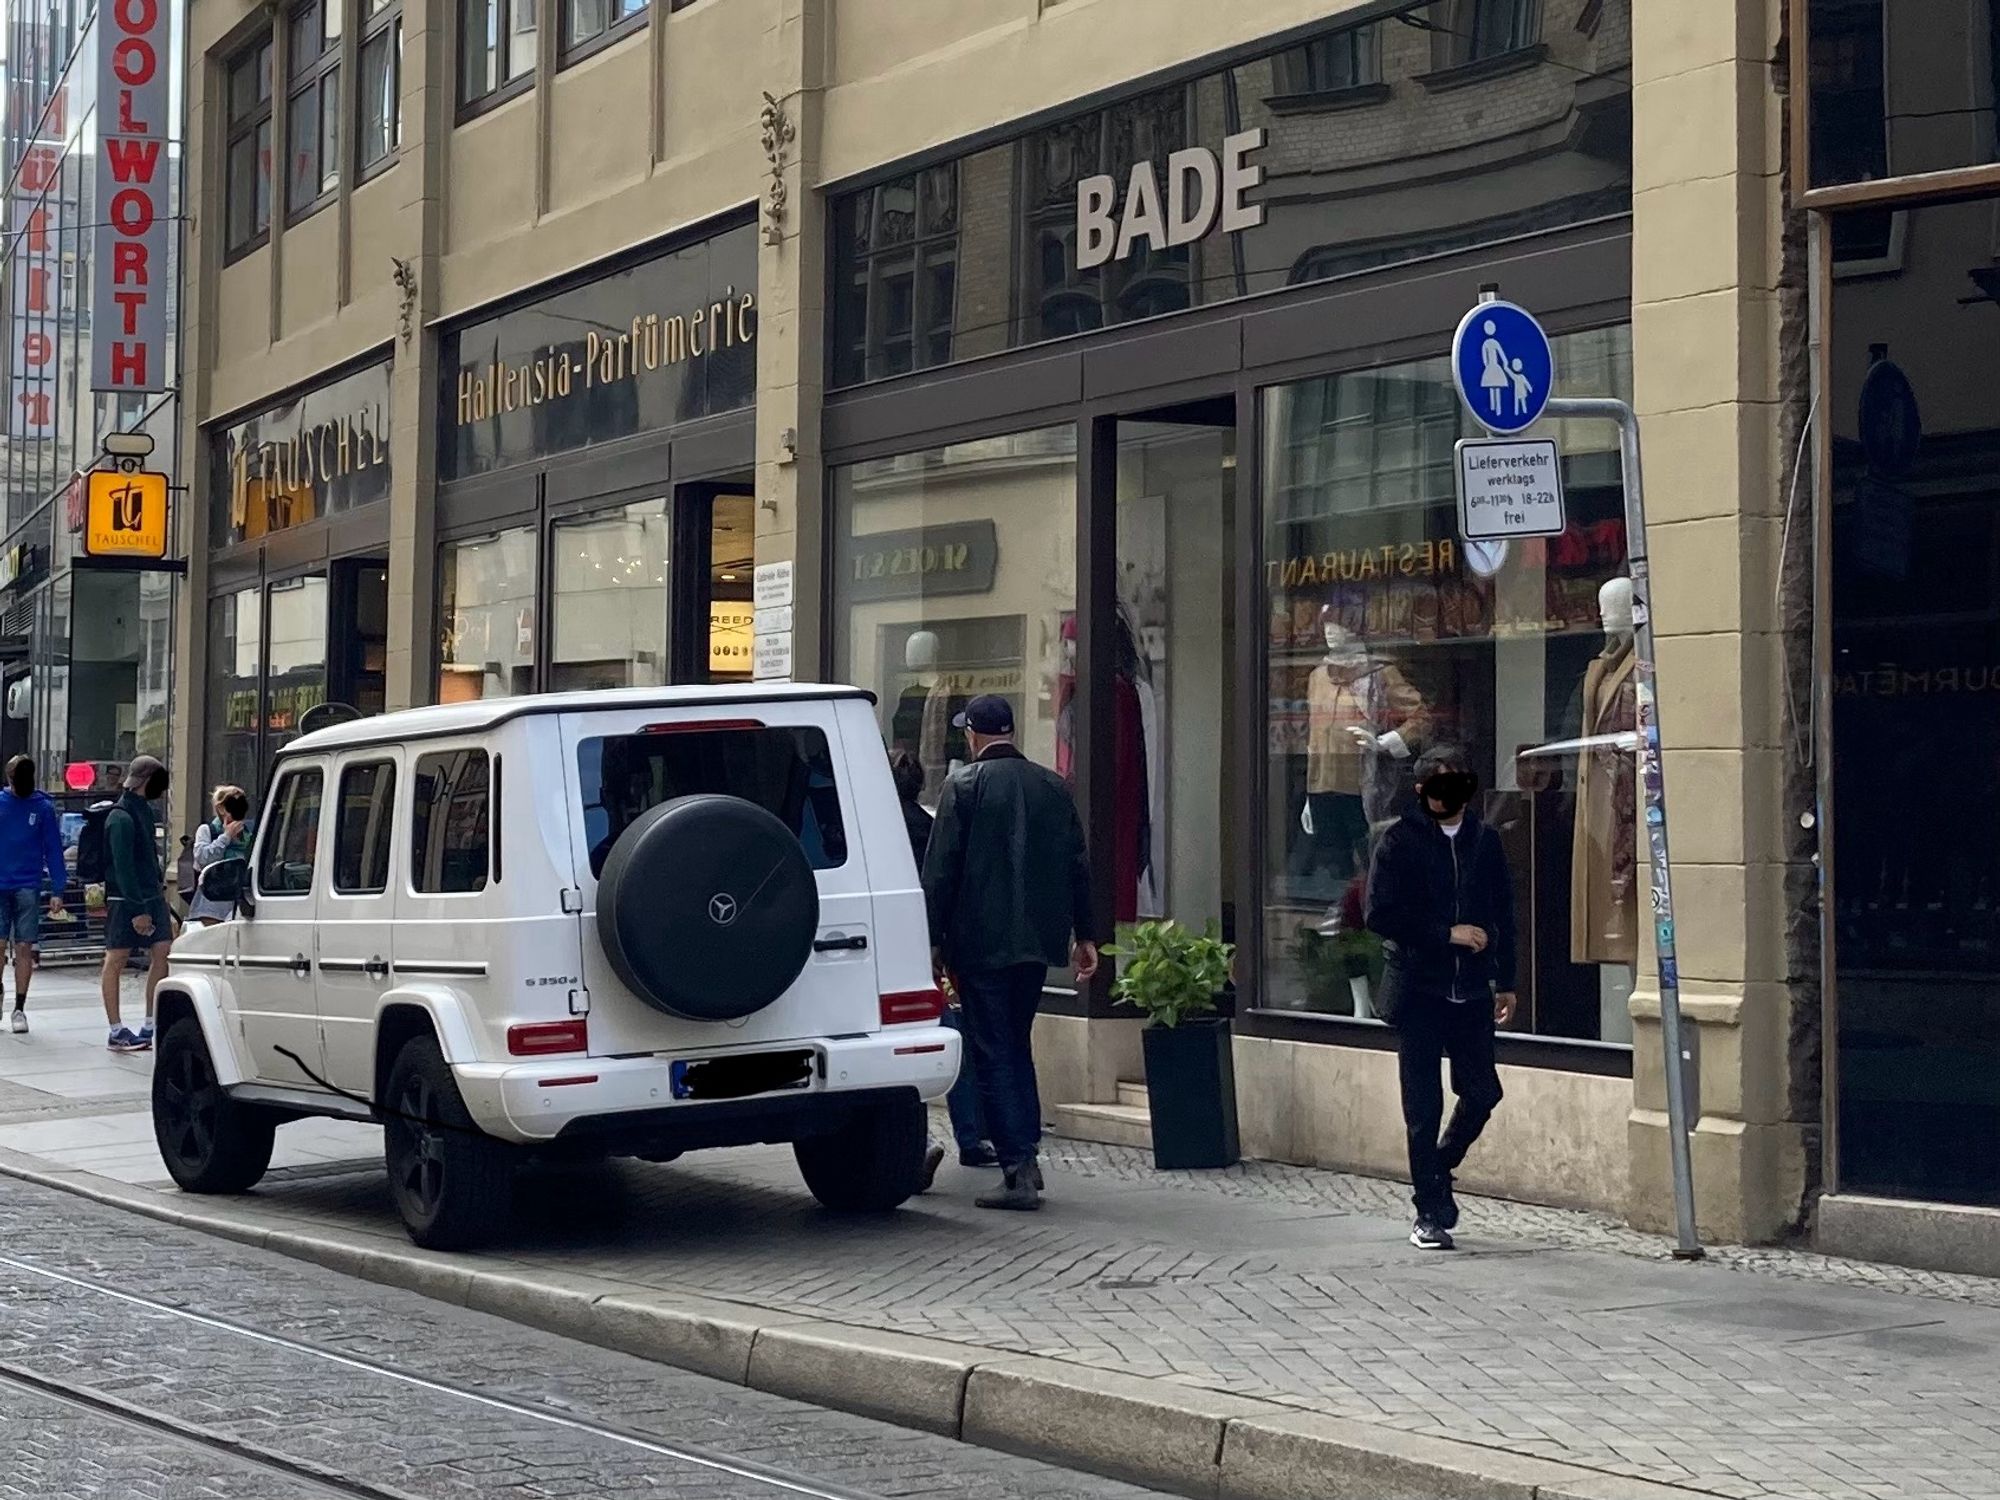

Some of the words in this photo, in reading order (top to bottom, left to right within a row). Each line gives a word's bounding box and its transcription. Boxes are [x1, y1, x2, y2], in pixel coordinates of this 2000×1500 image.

[105, 0, 160, 386] OOLWORTH
[1077, 128, 1268, 270] BADE
[457, 284, 754, 426] Hallensia-Parfümerie
[258, 403, 384, 502] TAUSCHEL
[1468, 452, 1550, 470] Lieferverkehr
[1487, 473, 1536, 487] werktags
[95, 533, 160, 547] TAUSCHEL
[1503, 510, 1526, 525] frei
